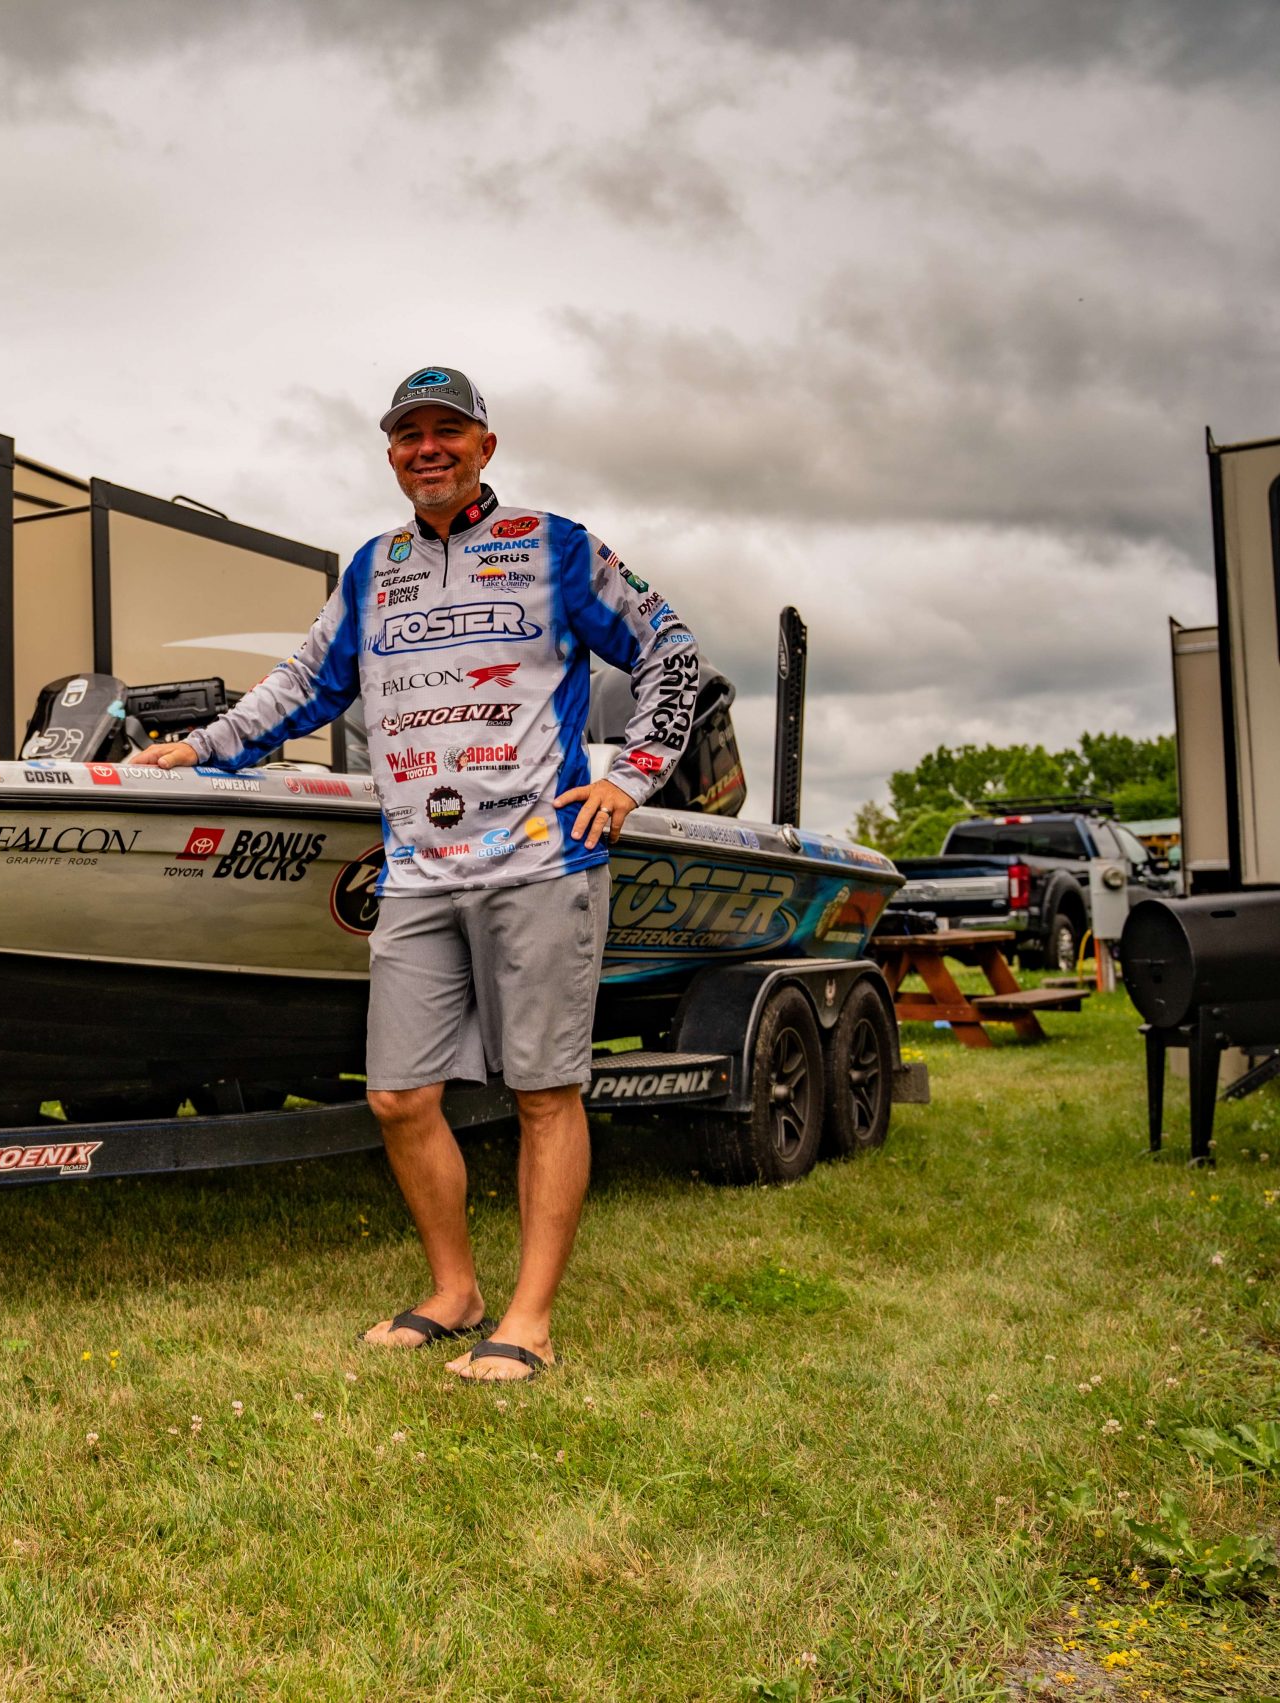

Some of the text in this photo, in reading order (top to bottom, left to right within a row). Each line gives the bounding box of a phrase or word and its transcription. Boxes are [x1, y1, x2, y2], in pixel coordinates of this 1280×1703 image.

[464, 538, 540, 554] LOWRANCE
[381, 571, 431, 588] GLEASON
[468, 571, 536, 583] TOLEDO BEND
[501, 579, 530, 589] Country
[388, 592, 419, 607] BUCKS
[389, 585, 420, 599] BONUS
[384, 602, 527, 650] FOSTER
[381, 667, 463, 697] FALCON
[645, 653, 684, 743] BONUS
[662, 653, 699, 752] BUCKS
[400, 704, 522, 732] PHOENIX
[25, 769, 74, 784] COSTA
[121, 766, 183, 781] TOYOTA
[405, 766, 435, 780] TOYOTA
[301, 778, 353, 798] YAMAHA
[430, 798, 461, 813] Pro-Guide
[479, 792, 541, 811] HI-SEAS
[228, 830, 327, 864] BONUS
[429, 843, 470, 860] YAMAHA
[477, 843, 517, 859] COSTA
[6, 856, 98, 866] GRAPHITE RODS
[212, 855, 311, 882] BUCKS
[163, 867, 205, 878] TOYOTA
[609, 856, 796, 935] FOSTER
[590, 1069, 714, 1099] PHOENIX
